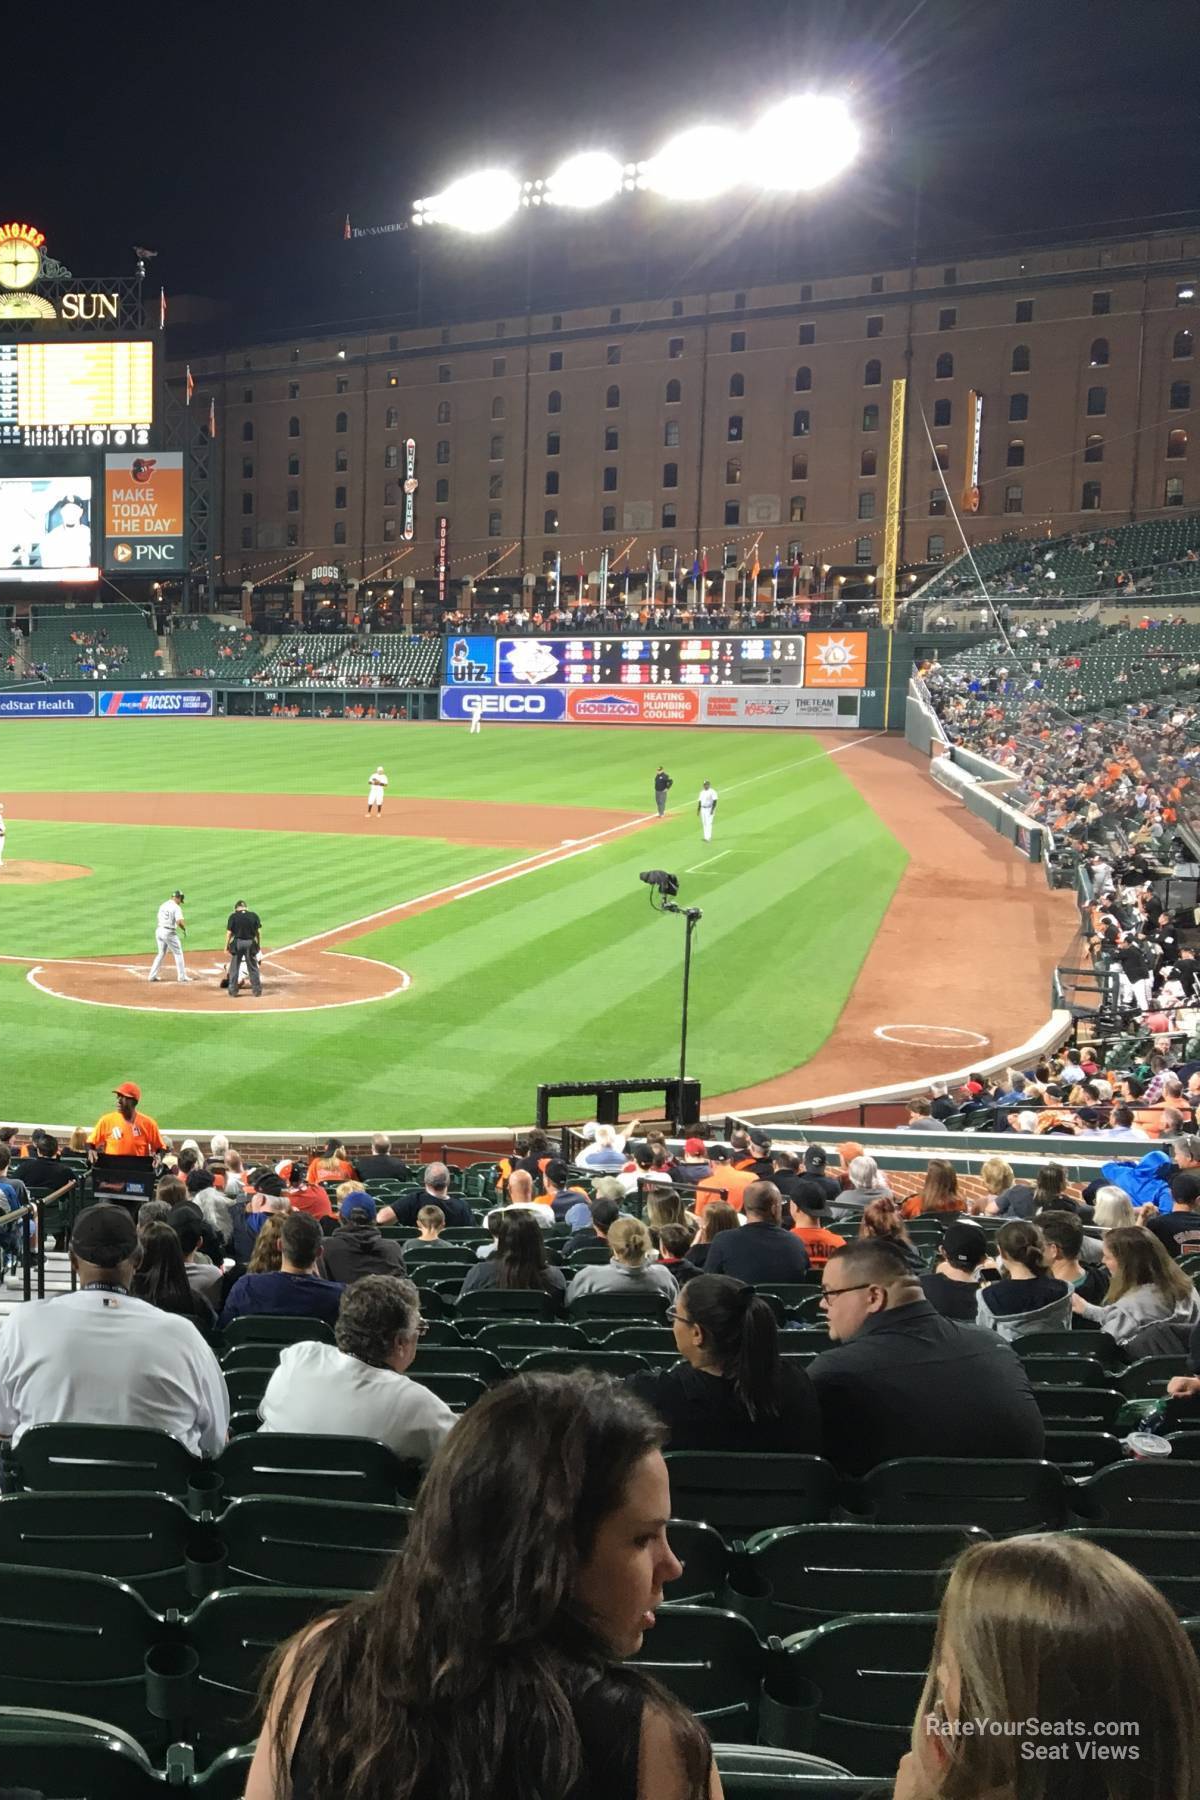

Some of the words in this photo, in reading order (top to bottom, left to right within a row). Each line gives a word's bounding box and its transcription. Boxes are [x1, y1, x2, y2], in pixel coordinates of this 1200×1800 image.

[62, 293, 119, 319] SUN
[112, 488, 155, 502] MAKE
[112, 503, 158, 517] TODAY
[112, 518, 141, 532] THE
[135, 544, 175, 560] PNC
[643, 692, 685, 701] HEATING
[37, 699, 75, 710] Health
[462, 695, 545, 713] GEICO
[577, 702, 639, 715] HORIZON
[643, 701, 691, 710] PLUMBING
[796, 698, 810, 709] THE
[812, 698, 834, 709] TEAM
[643, 710, 685, 719] COOLING
